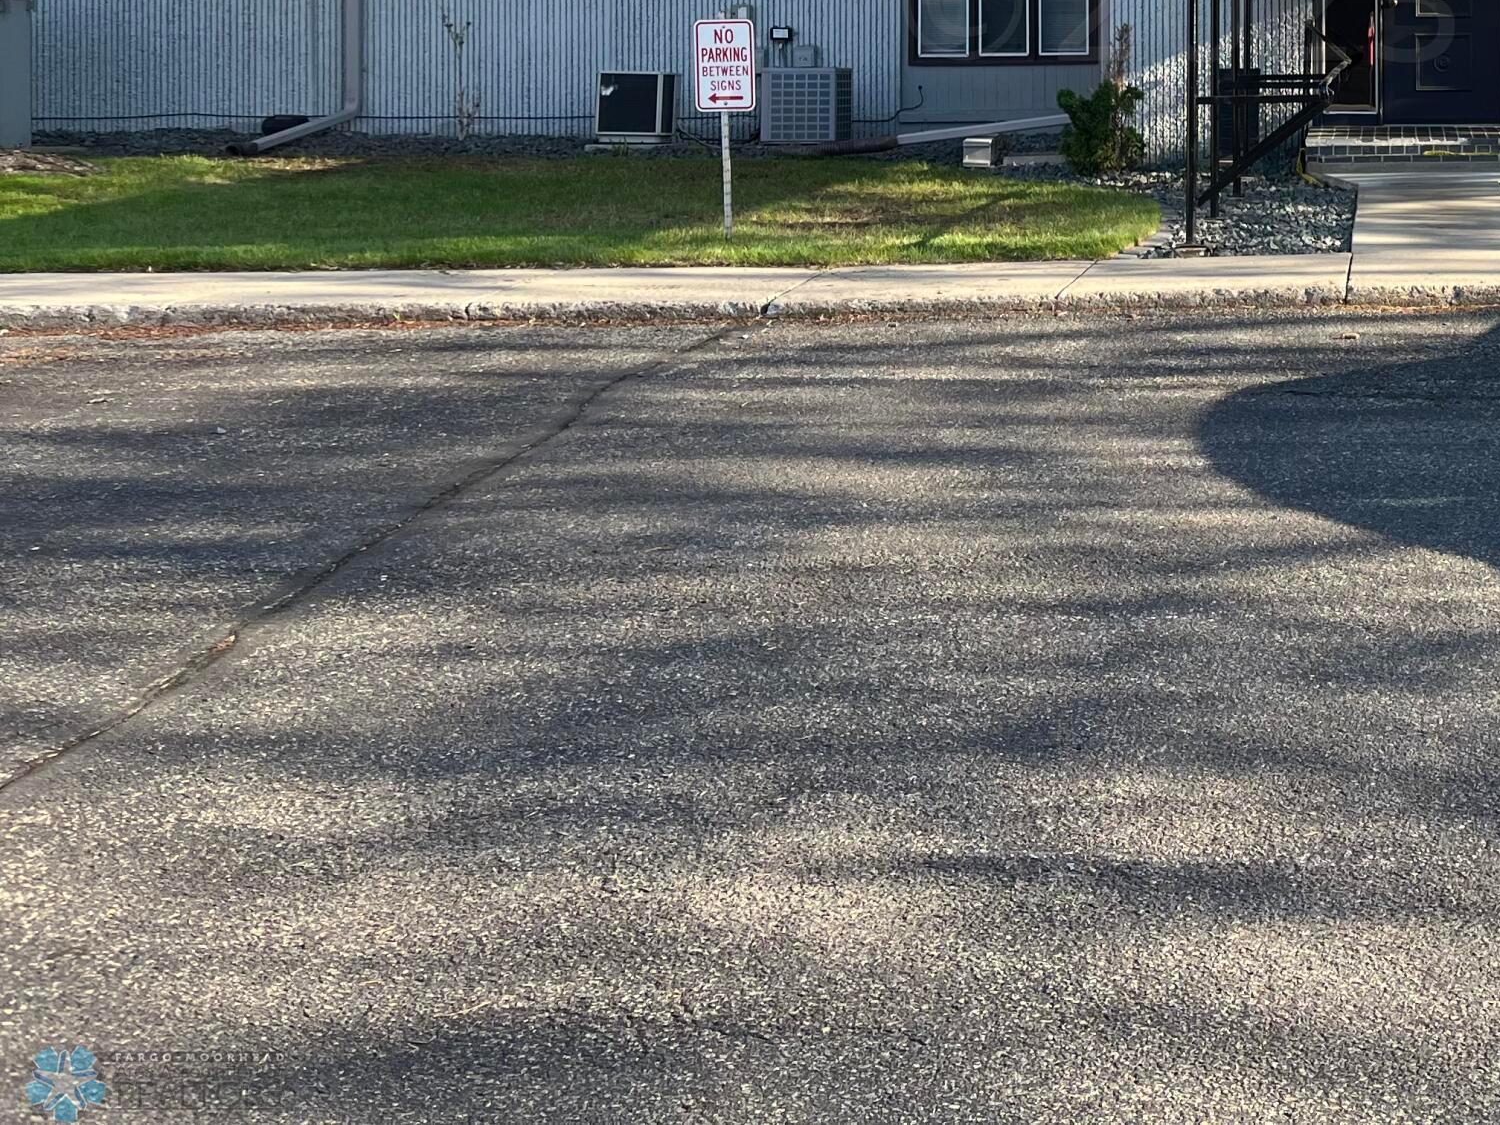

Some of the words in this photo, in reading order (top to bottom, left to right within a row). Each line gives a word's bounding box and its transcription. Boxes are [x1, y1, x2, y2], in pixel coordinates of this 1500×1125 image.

[714, 29, 734, 44] NO
[701, 47, 747, 62] PARKING
[702, 65, 749, 76] BETWEEN
[710, 80, 741, 91] SIGNS
